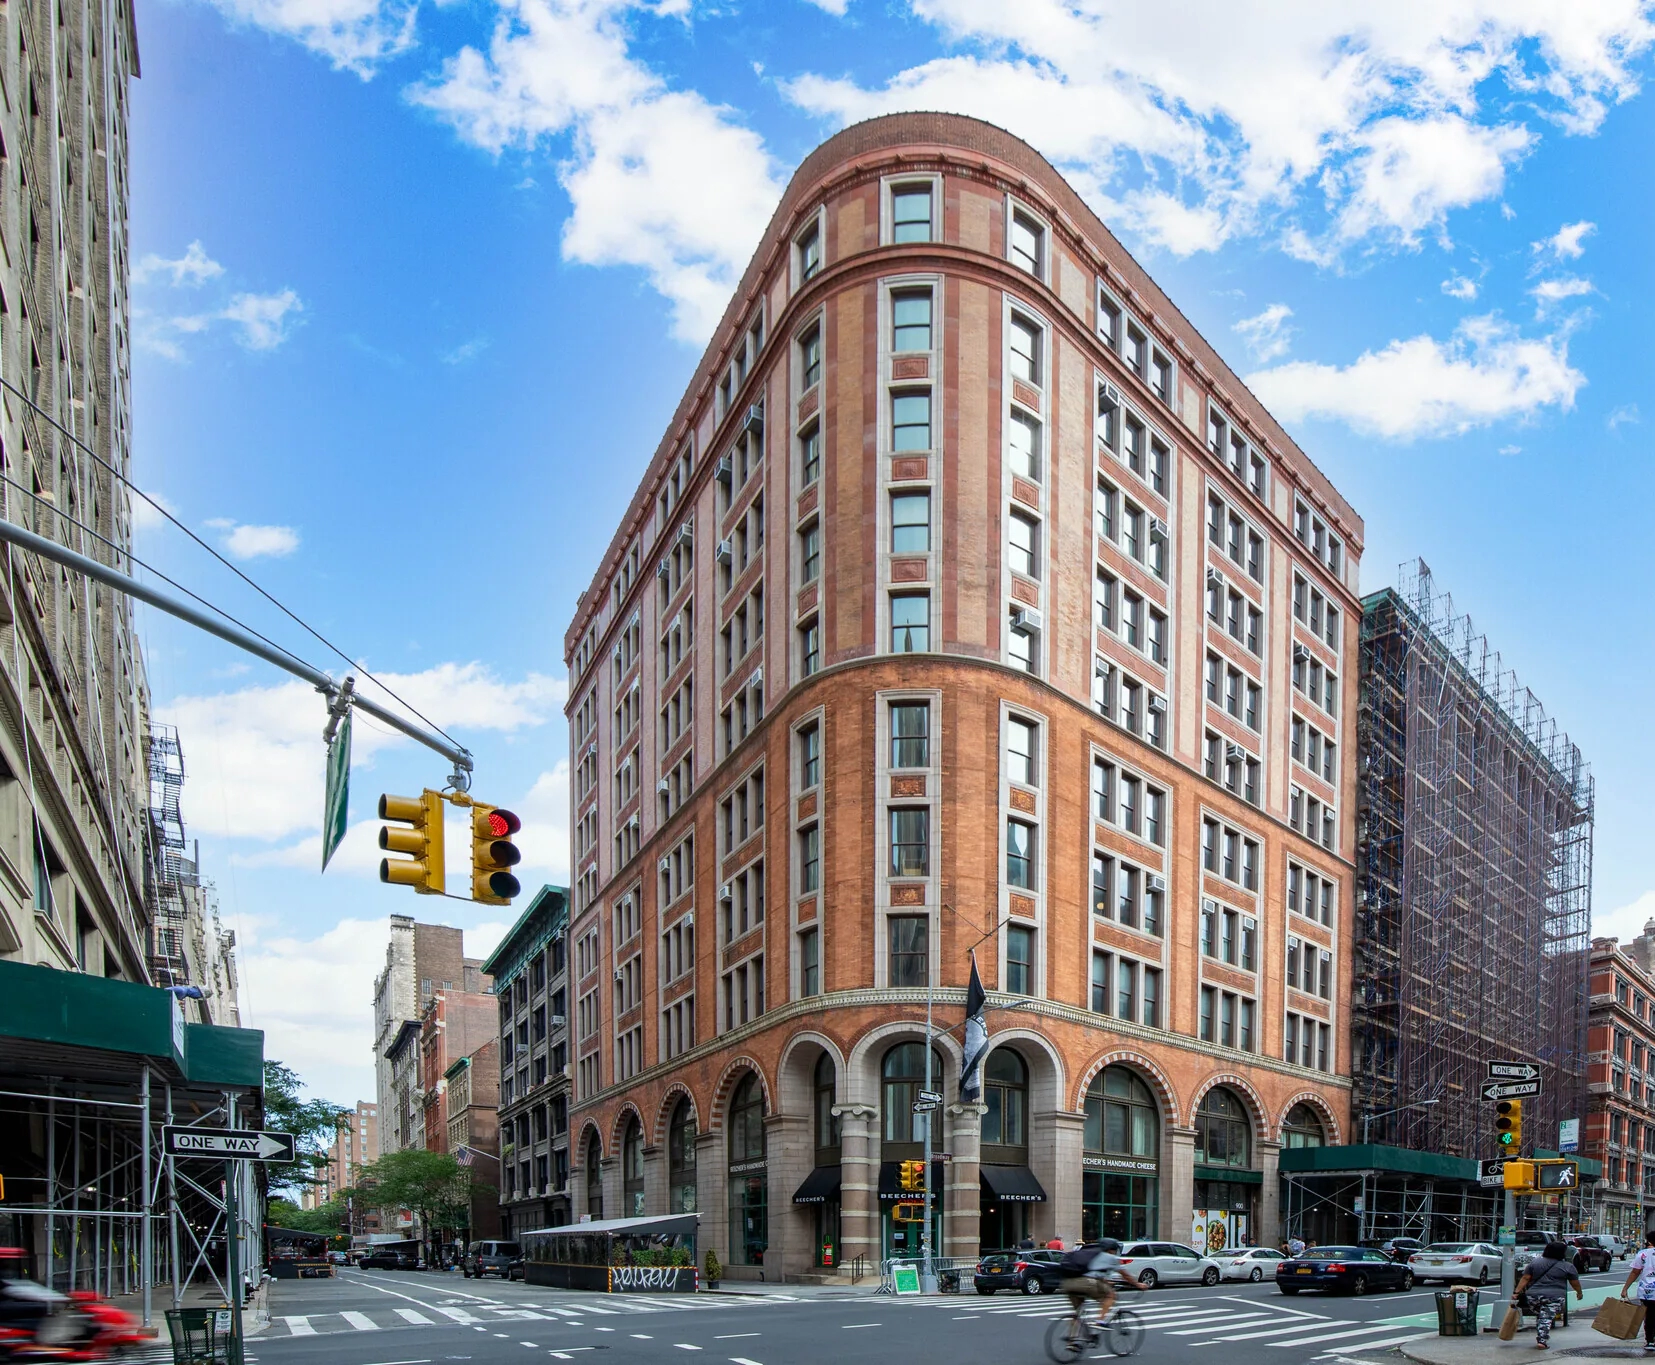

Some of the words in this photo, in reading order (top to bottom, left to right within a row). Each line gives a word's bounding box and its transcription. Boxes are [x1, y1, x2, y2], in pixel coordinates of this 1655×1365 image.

[1496, 1066, 1511, 1074] ONE
[1518, 1068, 1533, 1076] WAY
[1490, 1087, 1507, 1096] ONE
[1515, 1084, 1533, 1092] WAY
[179, 1135, 215, 1149] ONE
[224, 1138, 260, 1151] WAY
[1083, 1157, 1106, 1166] ECHER'S
[1107, 1159, 1136, 1168] HANDMADE
[1136, 1162, 1157, 1170] CHEESE
[1483, 1176, 1498, 1185] BIKE
[795, 1195, 825, 1203] BEECHER'S
